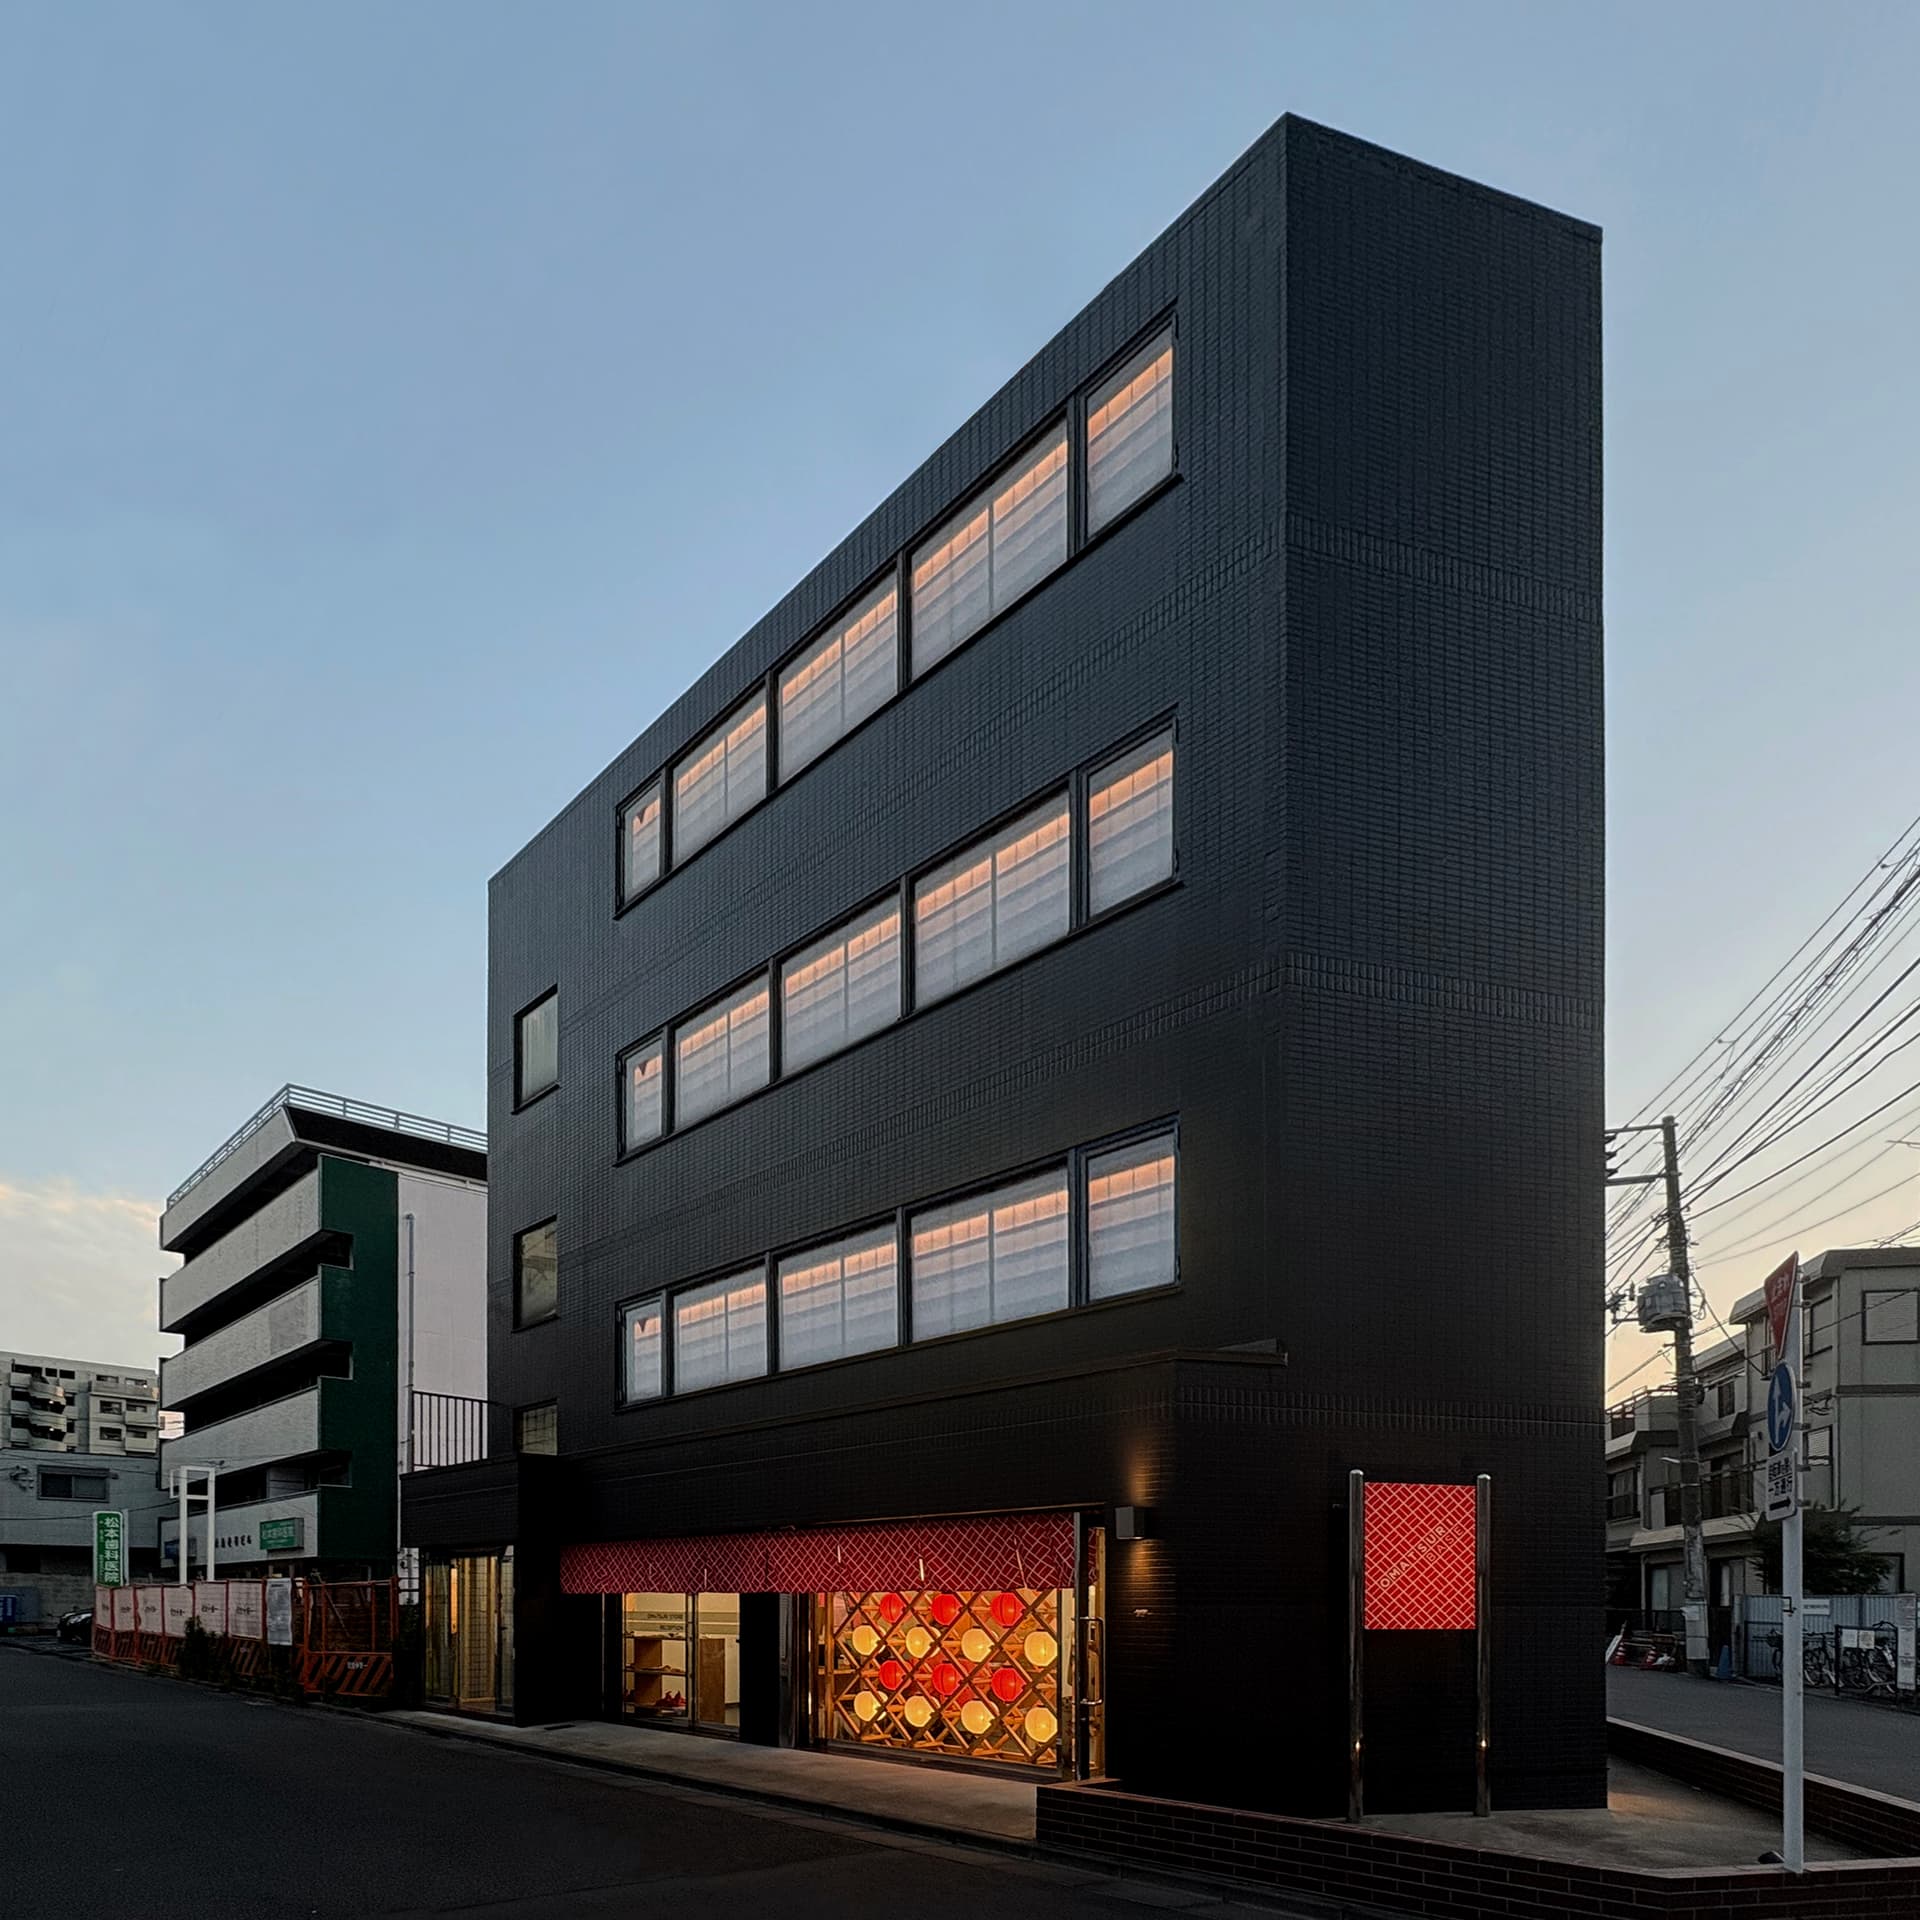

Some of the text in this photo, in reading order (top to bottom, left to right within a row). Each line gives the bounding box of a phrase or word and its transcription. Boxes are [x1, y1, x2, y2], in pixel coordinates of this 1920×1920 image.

[103, 1516, 120, 1583] 松本歯科医院
[1380, 1519, 1453, 1588] OMATSURI
[1426, 1525, 1465, 1562] BASE
